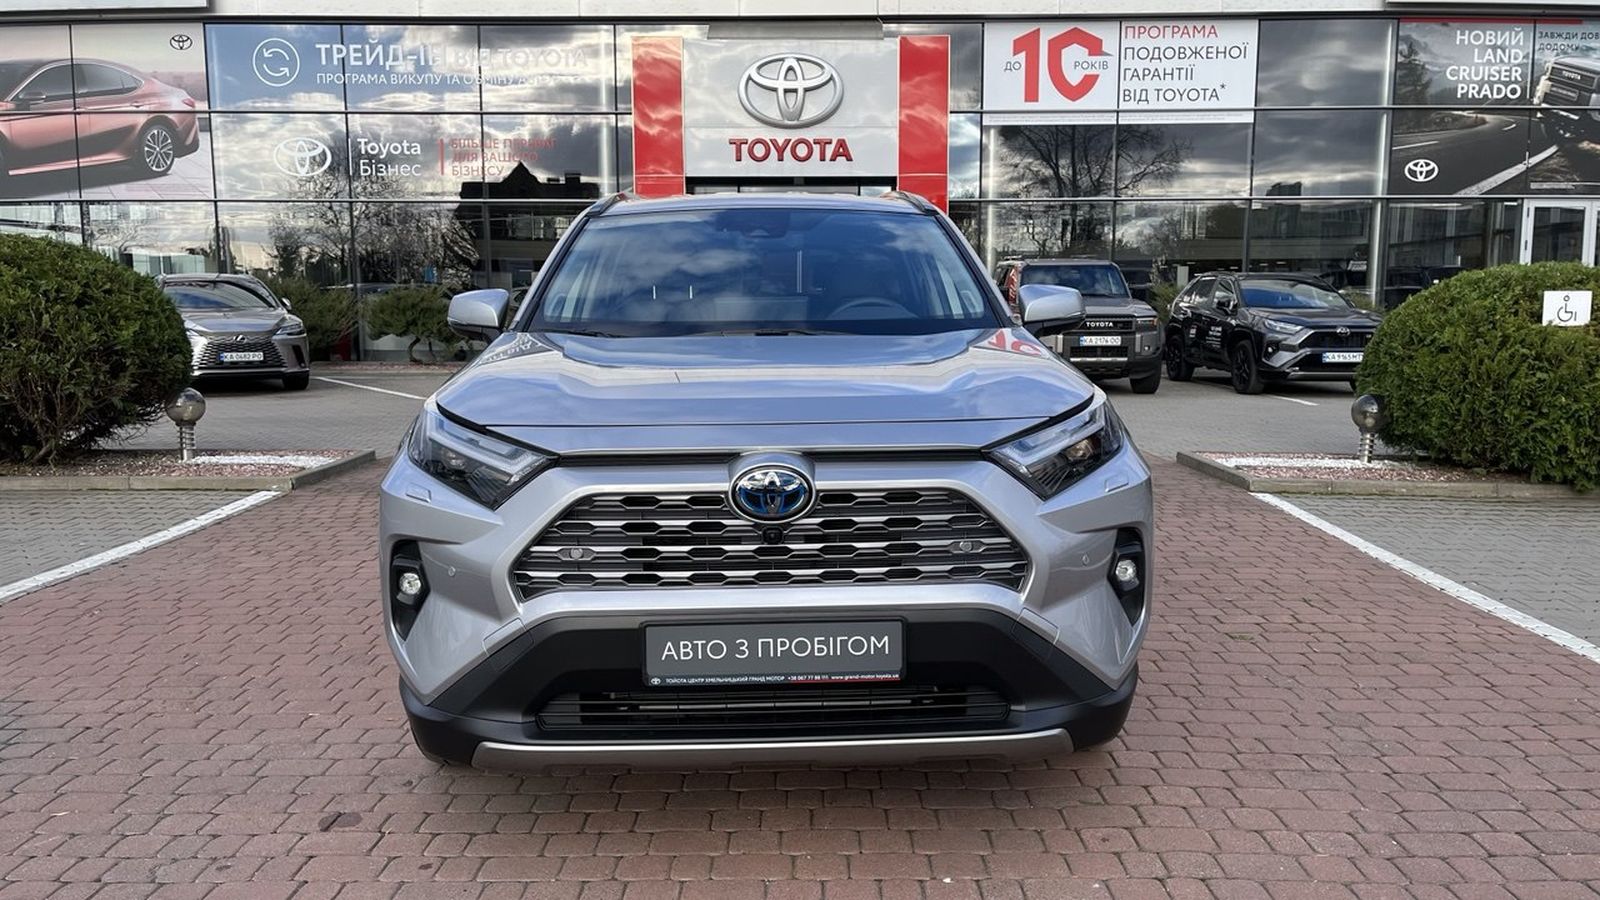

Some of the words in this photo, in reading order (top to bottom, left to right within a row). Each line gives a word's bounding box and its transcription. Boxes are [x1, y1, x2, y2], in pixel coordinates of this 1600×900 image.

[1124, 25, 1218, 39] ПРОГРАМА
[1456, 27, 1524, 46] НОВИЙ
[1538, 31, 1579, 40] ЗАВЖДИ
[1123, 42, 1249, 62] ПОДОВЖЕНОЇ
[1474, 48, 1523, 64] LAND
[1004, 61, 1022, 72] ДО
[1073, 61, 1109, 71] РОКІВ
[1122, 64, 1195, 82] ГАРАНТІЇ
[1446, 66, 1522, 81] CRUISER
[316, 73, 387, 85] ПРОГРАМА
[390, 73, 442, 85] ВИКУПУ
[446, 74, 460, 85] ТА
[1122, 88, 1149, 105] ВІД
[1457, 83, 1522, 99] PRADO
[357, 138, 421, 158] Toyota
[729, 138, 853, 162] TOYOTA
[359, 159, 421, 176] Бізнес
[661, 640, 727, 660] АВТО
[757, 635, 889, 658] ПРОБІГОМ
